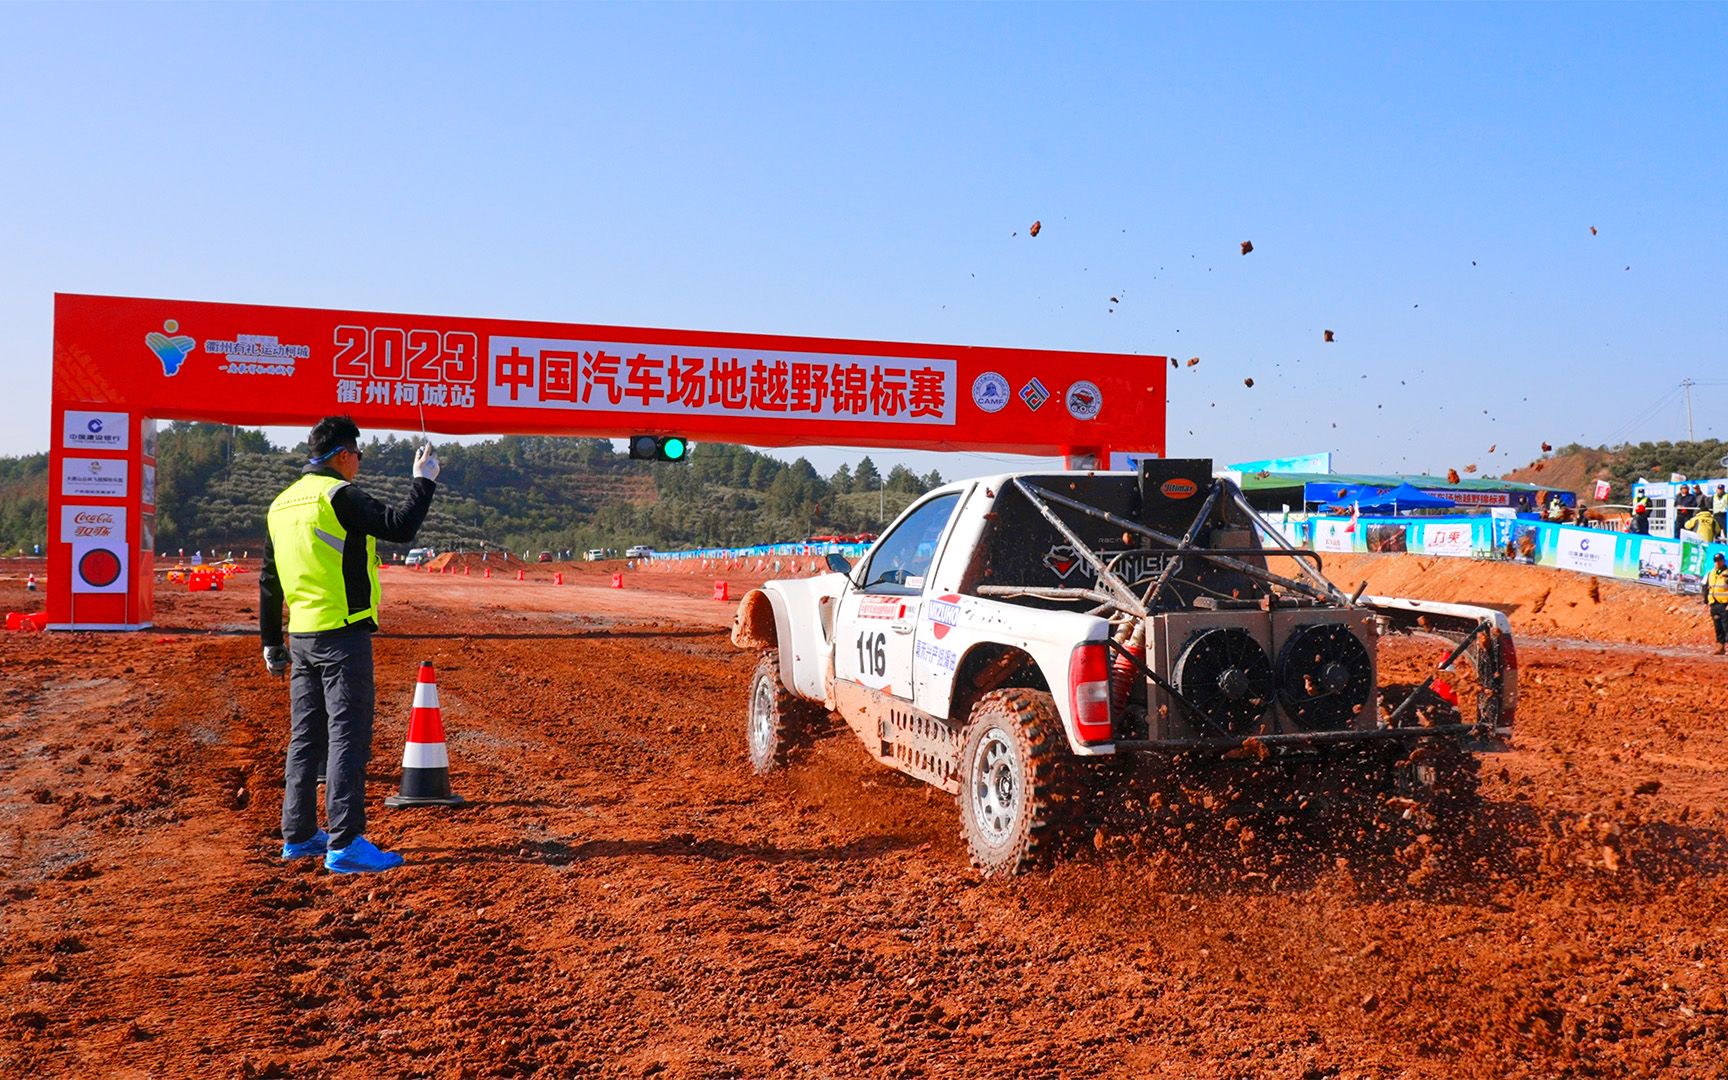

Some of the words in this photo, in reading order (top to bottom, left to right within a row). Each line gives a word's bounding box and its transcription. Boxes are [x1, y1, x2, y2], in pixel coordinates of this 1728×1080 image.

[333, 325, 478, 383] 2023
[336, 378, 477, 409] 衢州柯城站
[495, 345, 946, 418] 中国汽车场地越野锦标赛
[977, 397, 1005, 406] CAMF
[928, 600, 961, 626] MIZUHO
[857, 630, 886, 678] 116
